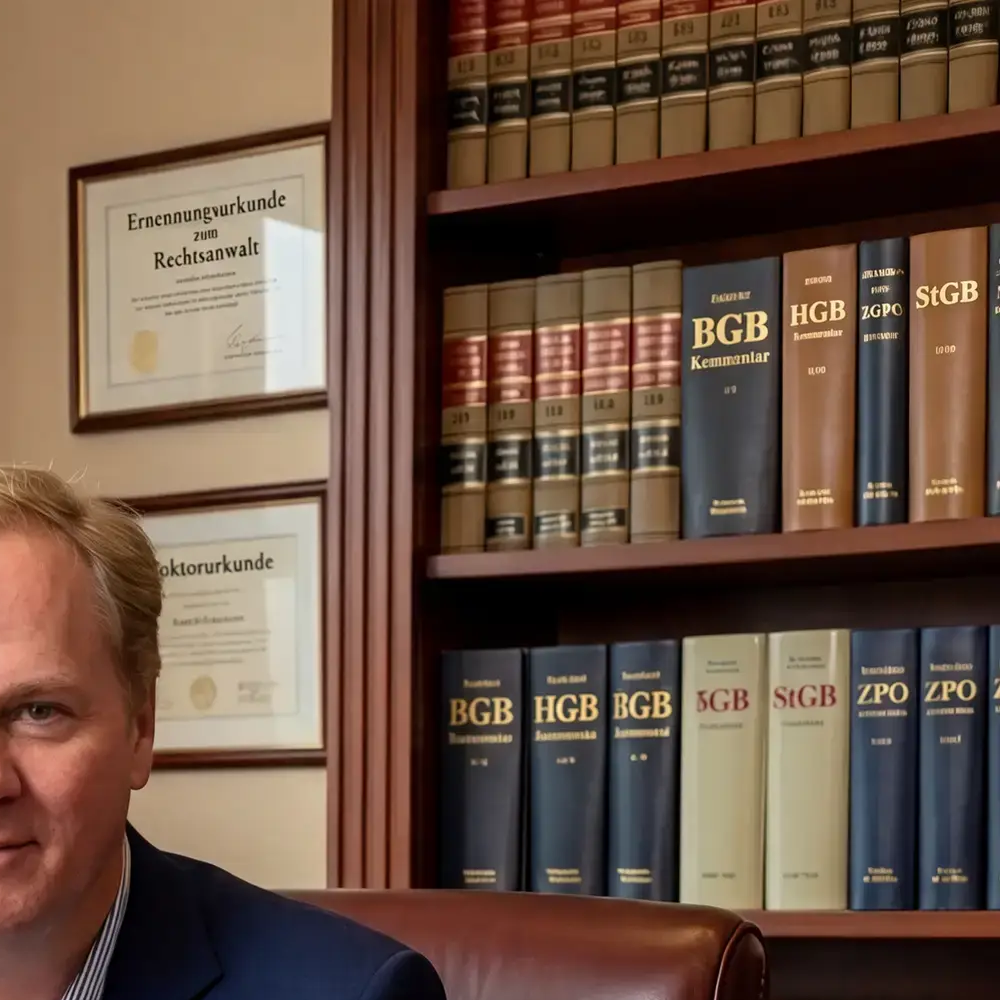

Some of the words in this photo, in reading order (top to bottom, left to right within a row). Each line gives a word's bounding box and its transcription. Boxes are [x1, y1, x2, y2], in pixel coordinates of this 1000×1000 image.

[153, 236, 260, 270] Rechtsanwalt
[915, 280, 979, 310] StGB
[790, 299, 846, 327] HGB
[861, 302, 903, 320] ZGPO
[691, 310, 769, 350] BGB
[159, 552, 274, 577] oktorurkunde
[773, 684, 838, 710] StGB
[857, 681, 909, 705] ZPO
[924, 679, 977, 702] ZPO
[450, 697, 514, 726] BGB
[533, 693, 599, 724] HGB
[613, 690, 673, 720] BGB
